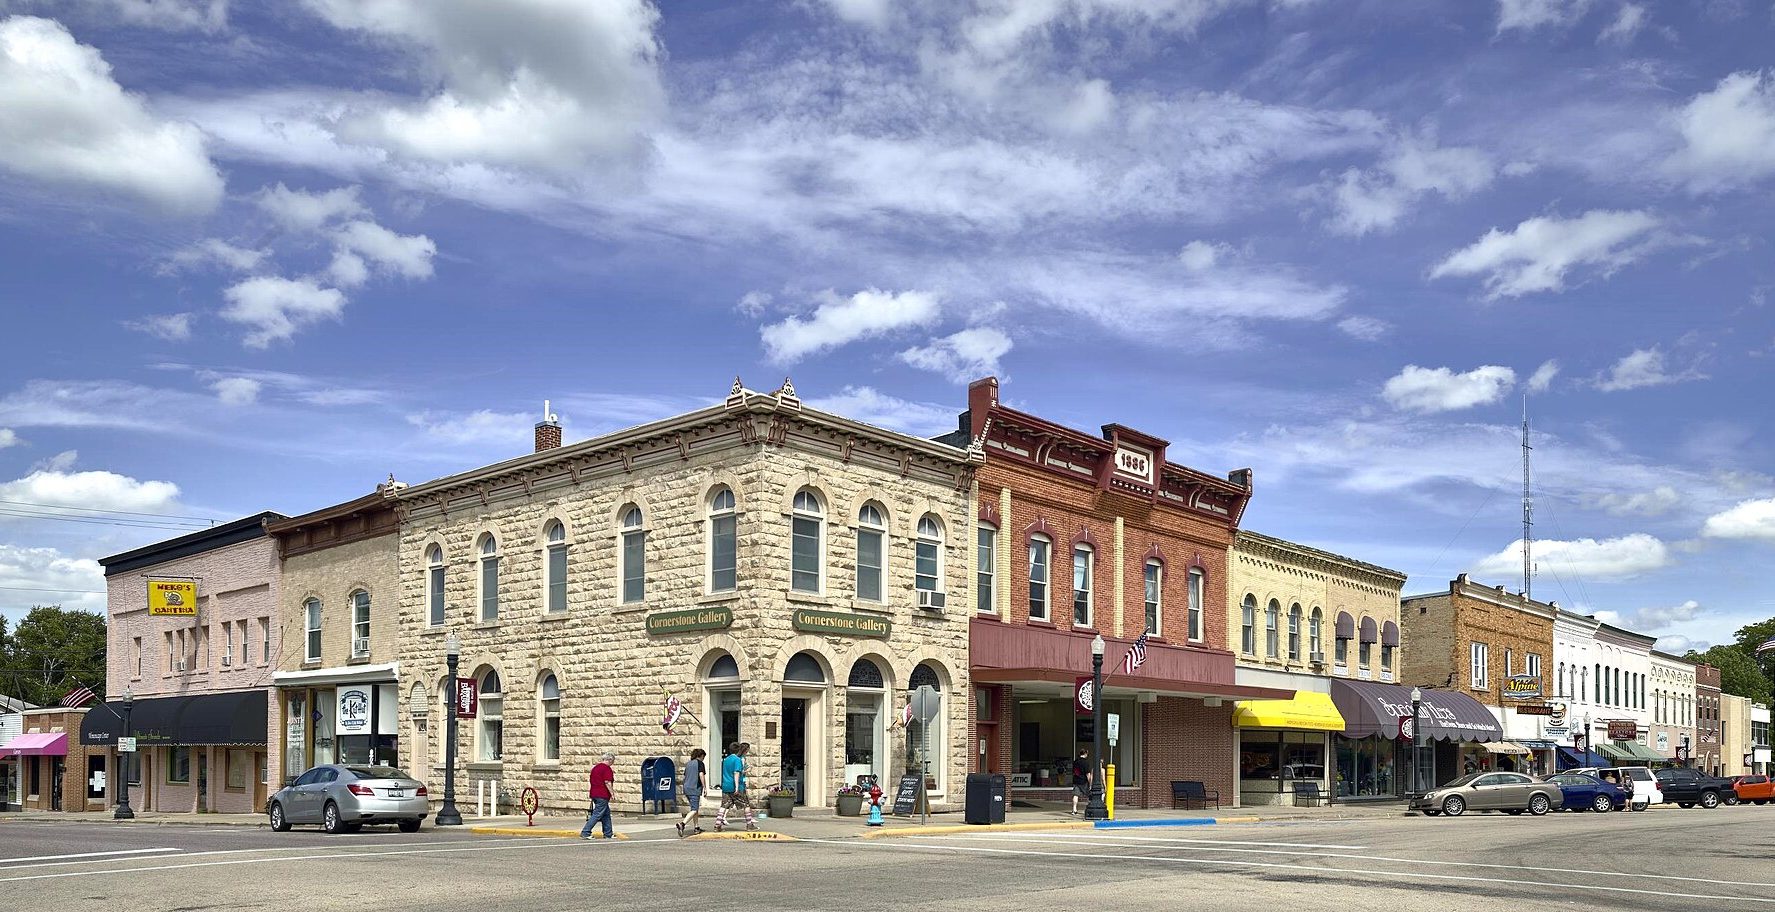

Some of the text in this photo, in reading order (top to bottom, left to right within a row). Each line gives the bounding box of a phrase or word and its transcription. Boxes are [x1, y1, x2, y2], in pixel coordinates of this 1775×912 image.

[1121, 453, 1145, 472] 1886
[649, 611, 728, 629] Cornerstone Gallery
[798, 611, 888, 635] Cornerstone Gallery
[1505, 679, 1539, 691] Alpine
[1517, 706, 1551, 715] RESTAURANT
